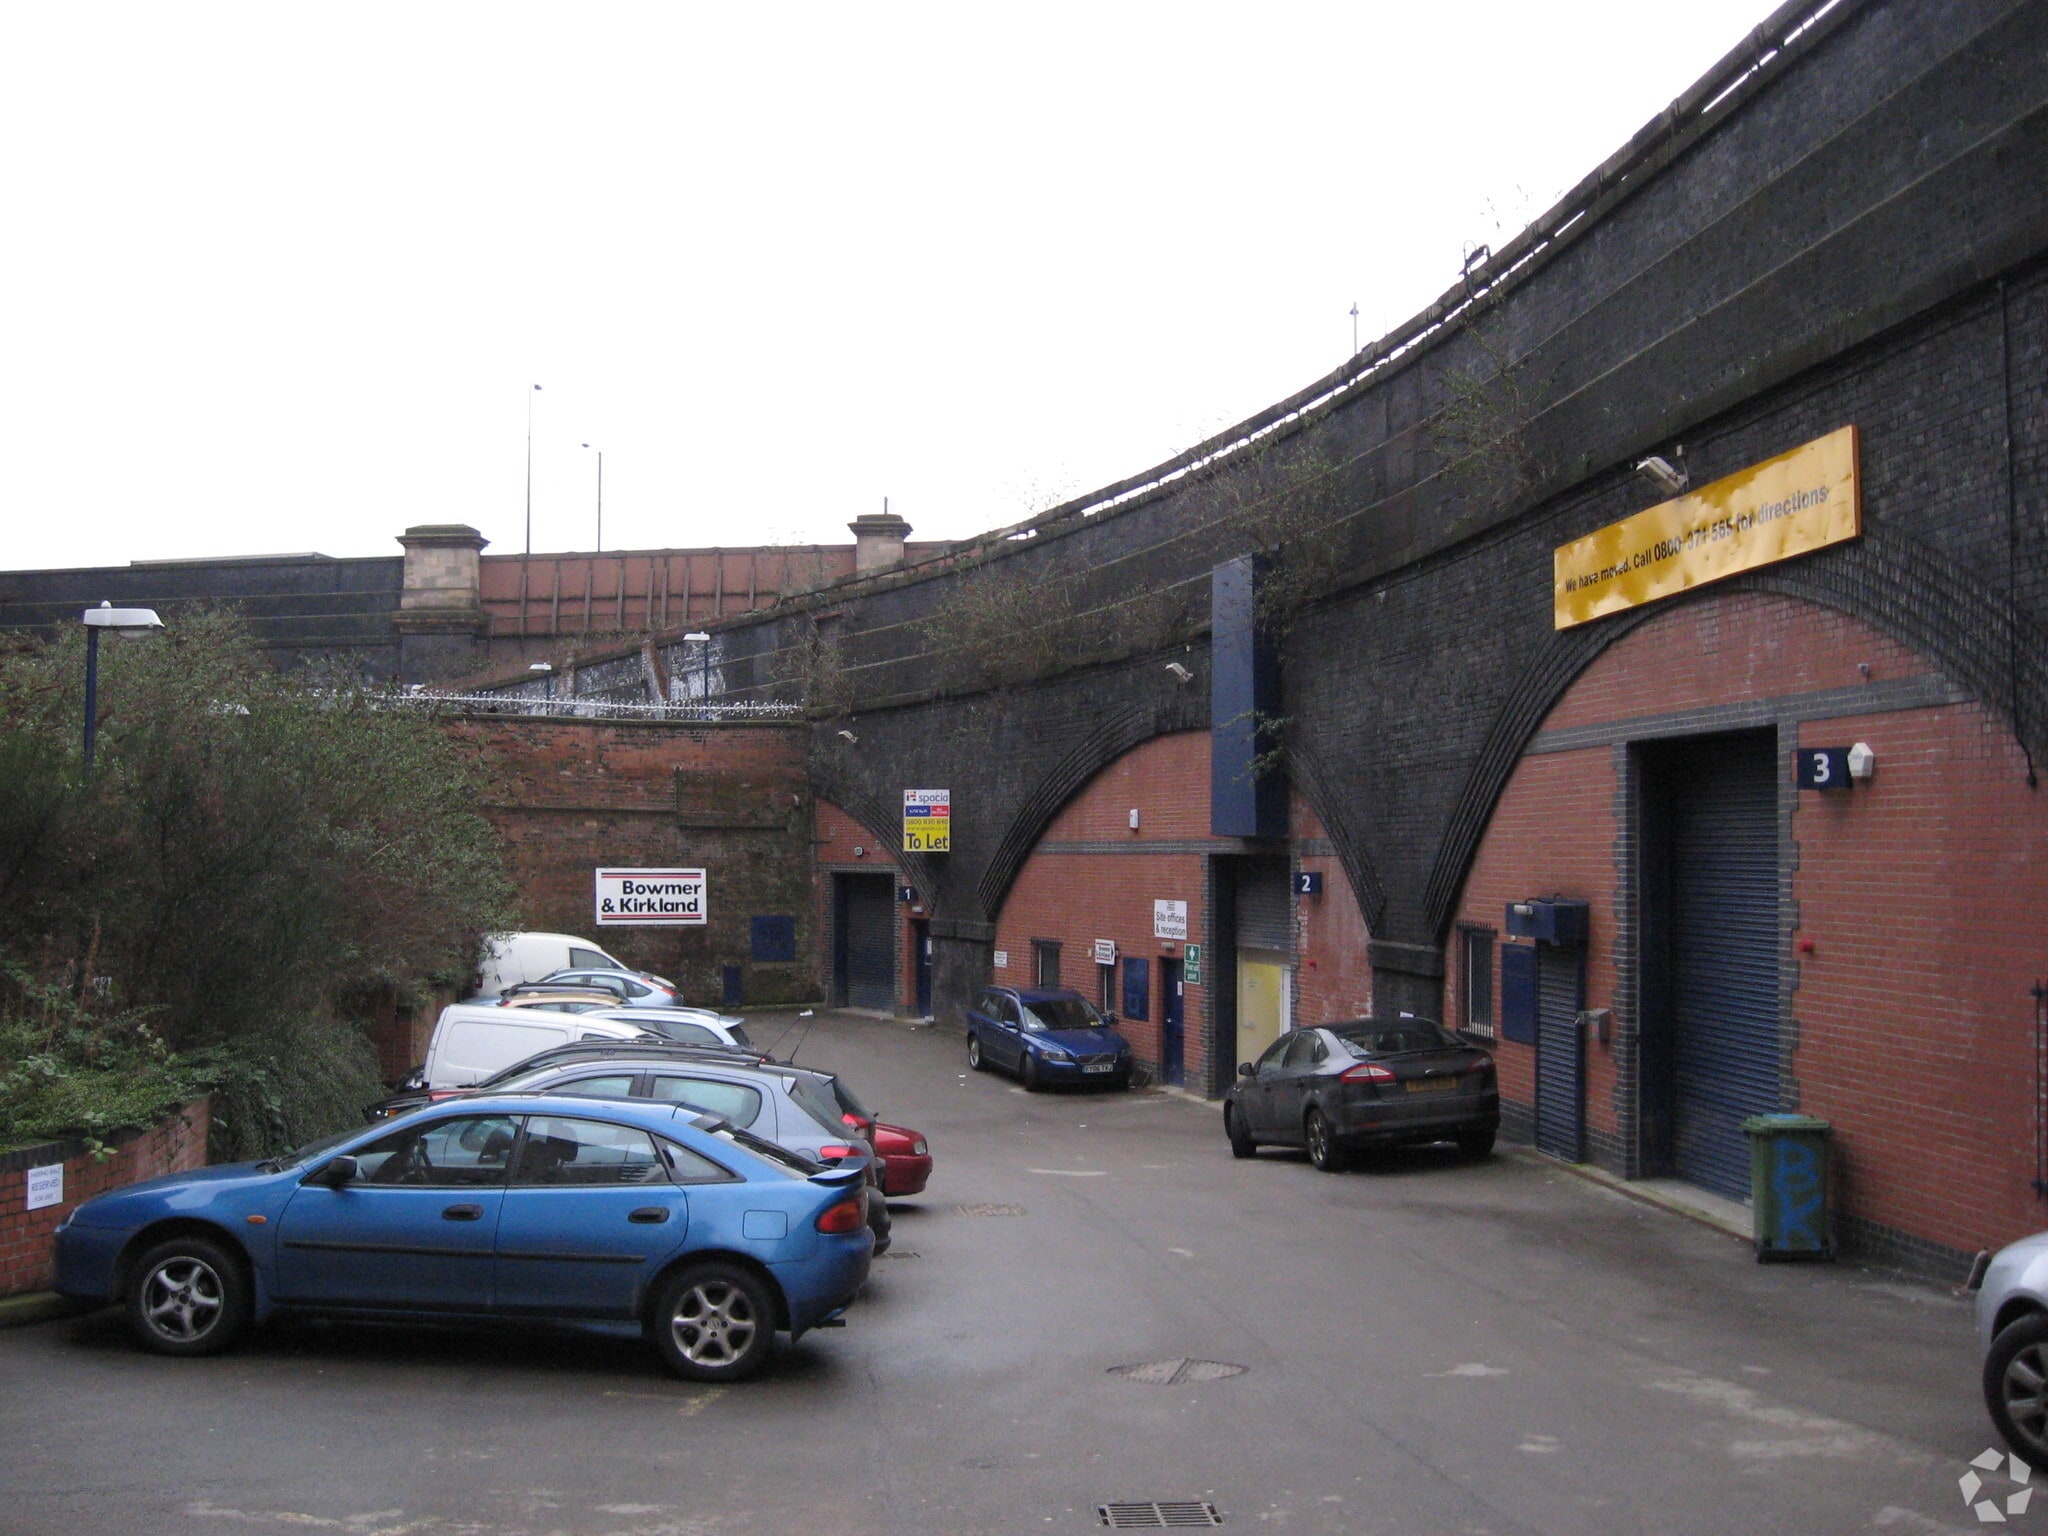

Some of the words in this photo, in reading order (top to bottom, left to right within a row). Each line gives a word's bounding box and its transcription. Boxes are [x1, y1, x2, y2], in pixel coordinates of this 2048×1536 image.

[1565, 579, 1577, 593] We
[1578, 571, 1599, 589] have
[1601, 557, 1632, 581] moved.
[1633, 548, 1652, 569] Call
[1654, 535, 1682, 561] 0800
[1687, 526, 1707, 550] 371
[1711, 516, 1733, 541] 565
[1736, 510, 1754, 533] for
[1758, 485, 1828, 525] directions
[1813, 753, 1830, 782] 3
[919, 793, 949, 804] spacia
[906, 832, 921, 849] To
[926, 832, 949, 849] Let
[622, 880, 702, 895] Bowmer
[1301, 875, 1311, 893] 2
[905, 888, 910, 900] 1
[601, 897, 616, 913] &
[619, 897, 698, 913] Kirkland
[1156, 911, 1166, 921] Site
[1167, 912, 1185, 924] offices
[1161, 926, 1186, 937] reception
[31, 1178, 60, 1191] RESERVED
